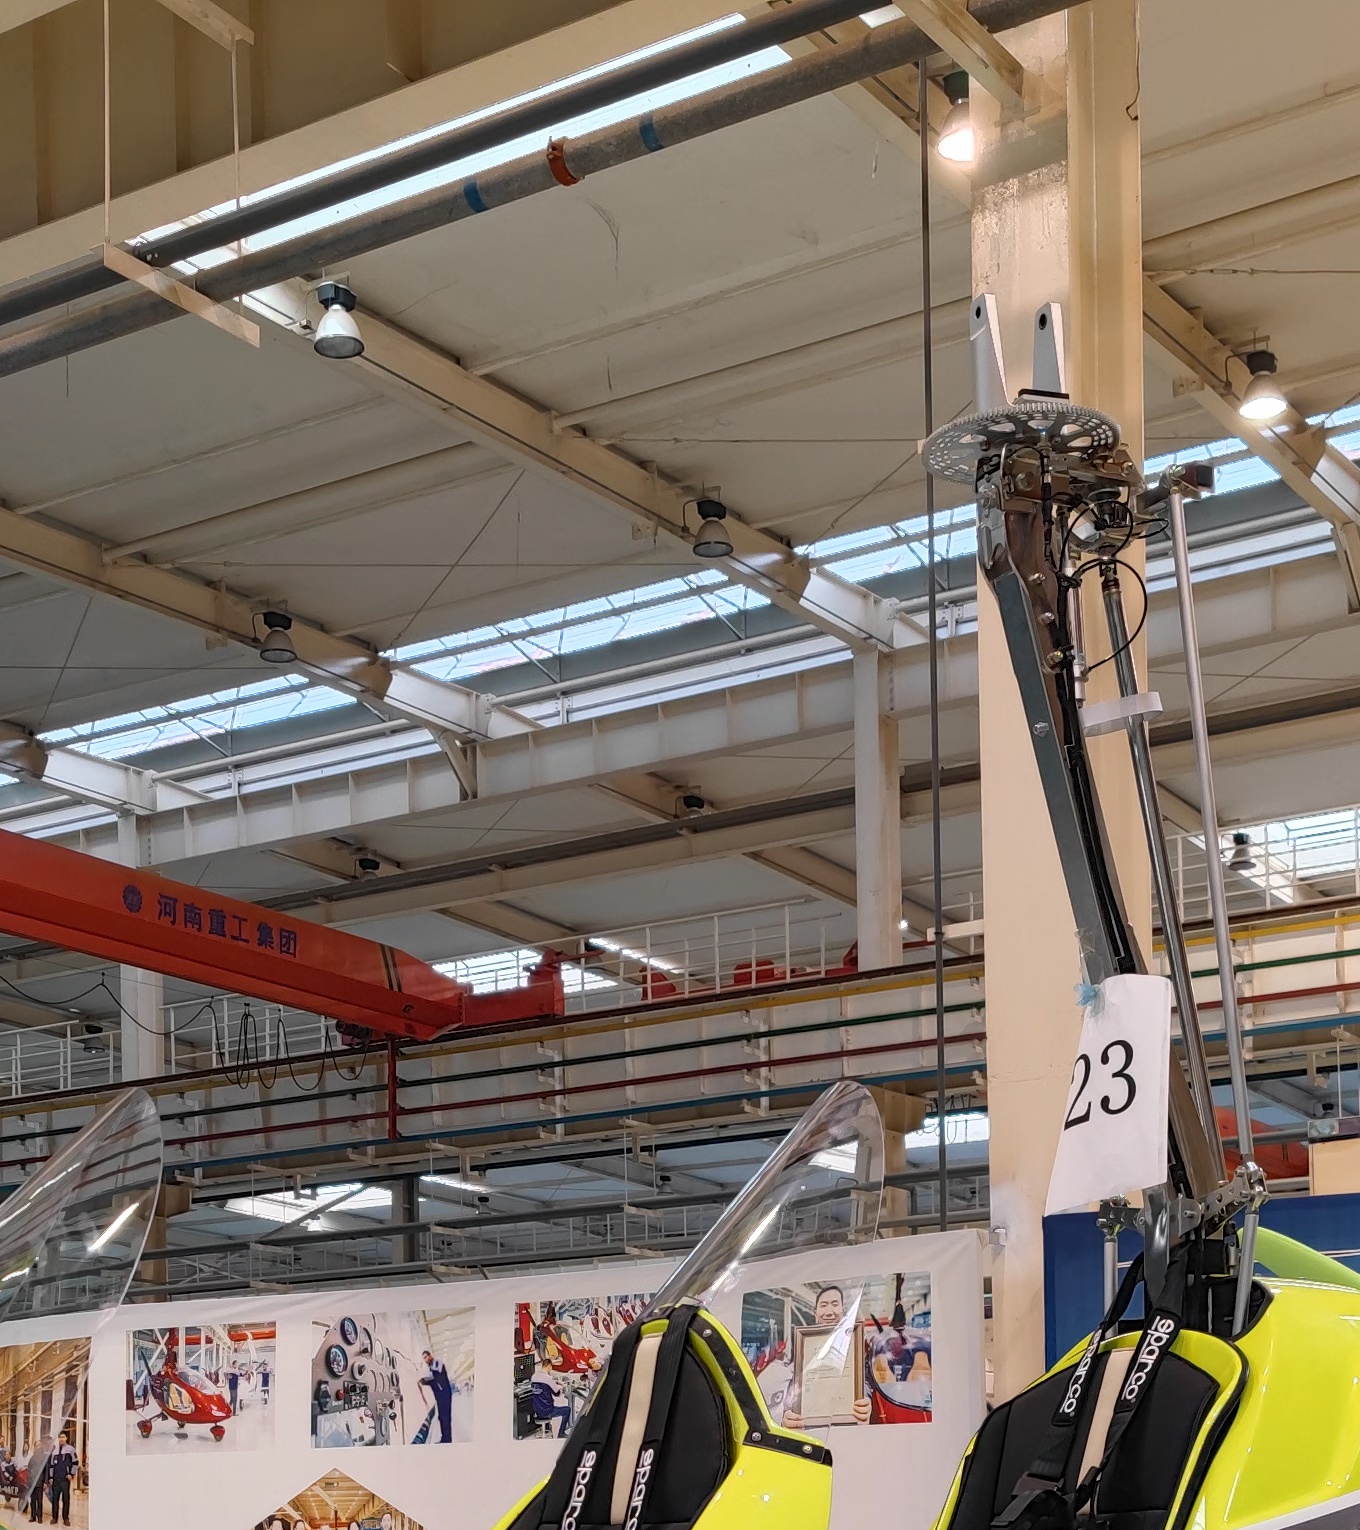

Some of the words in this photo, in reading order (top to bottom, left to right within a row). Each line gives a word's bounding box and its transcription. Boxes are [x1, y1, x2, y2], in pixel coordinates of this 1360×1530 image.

[157, 892, 297, 959] 河南重工集团
[1063, 1039, 1137, 1132] 23
